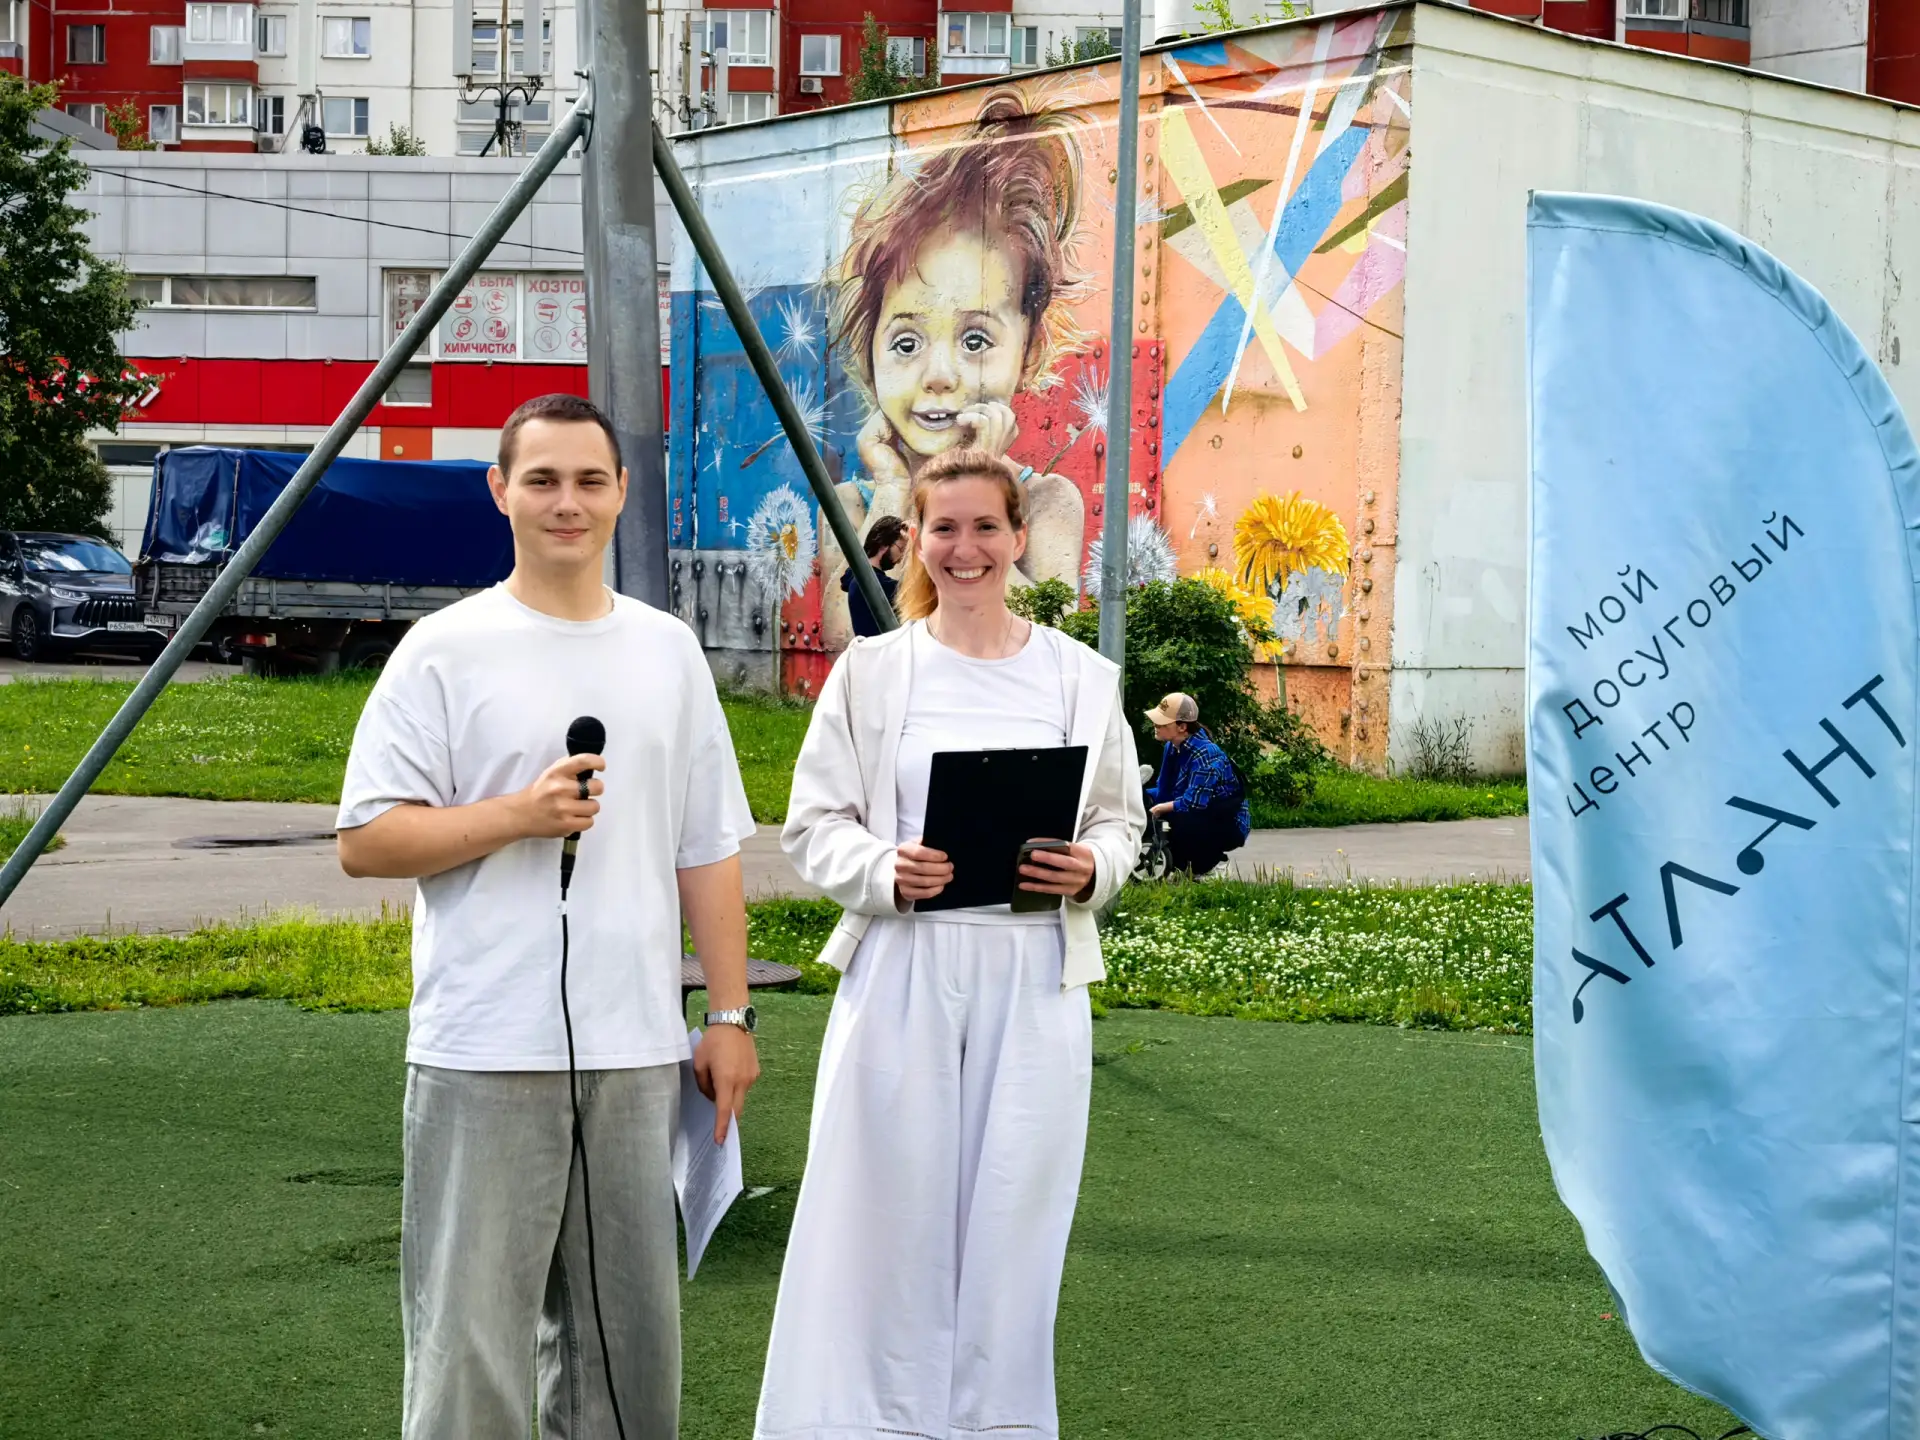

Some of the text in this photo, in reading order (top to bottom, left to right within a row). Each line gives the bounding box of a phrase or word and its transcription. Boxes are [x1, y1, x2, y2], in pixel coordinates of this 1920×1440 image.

[479, 276, 514, 287] БЫТА
[443, 342, 517, 354] ХИМЧИСТКА
[1562, 511, 1805, 740] досуговый
[1567, 564, 1659, 649] мой
[1568, 701, 1696, 818] центр
[1571, 674, 1906, 1024] АТЛАНТ
